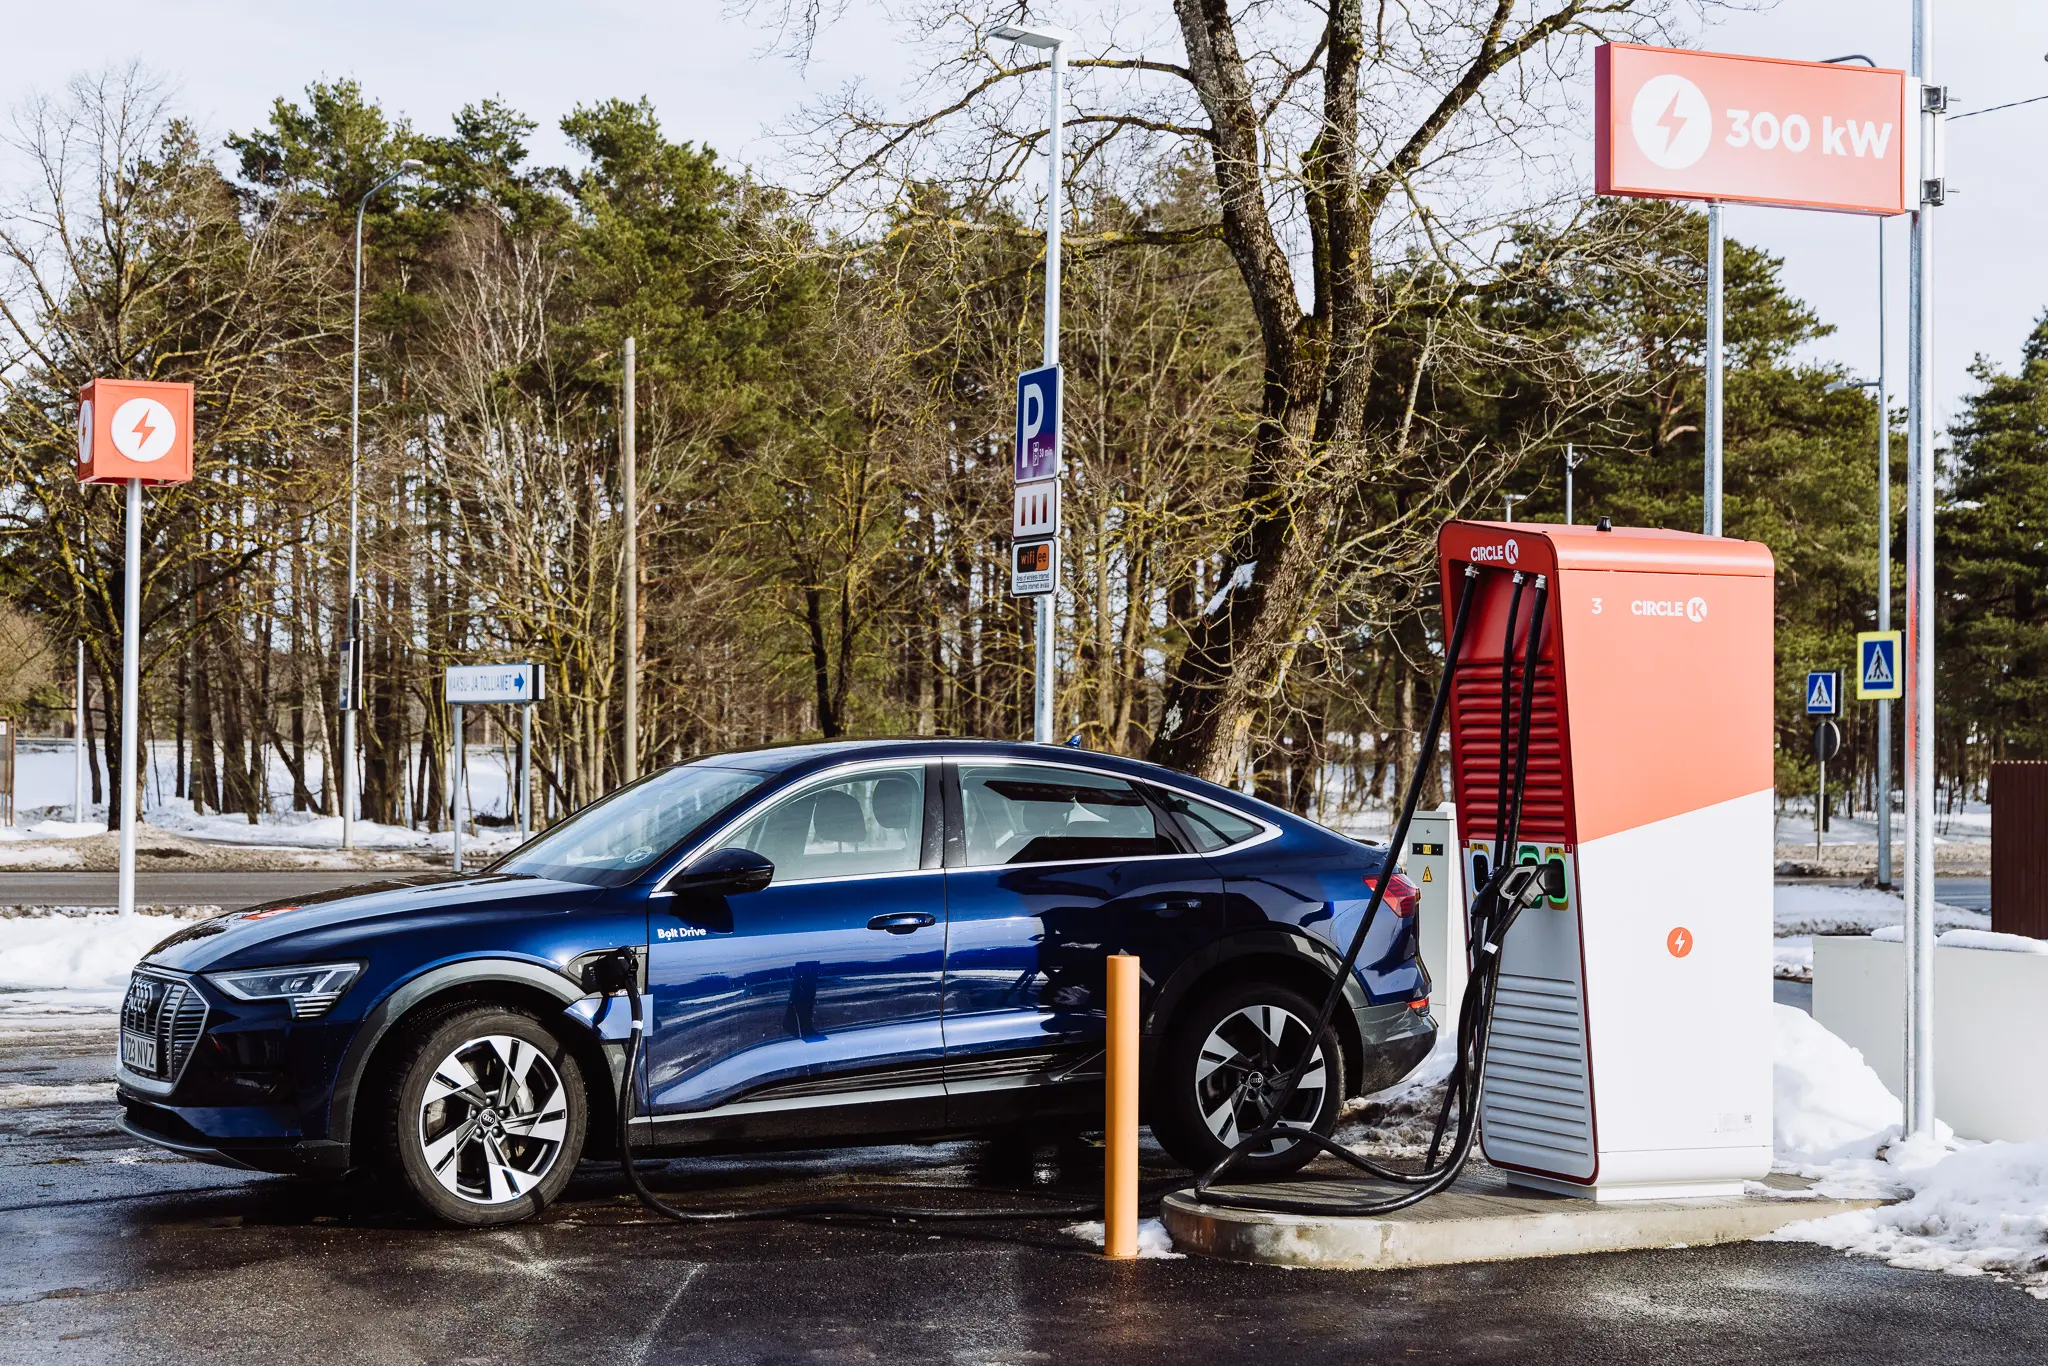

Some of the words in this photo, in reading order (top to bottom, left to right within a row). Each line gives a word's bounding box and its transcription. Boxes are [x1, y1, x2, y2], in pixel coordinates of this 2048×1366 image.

[1725, 108, 1811, 154] 300
[1822, 115, 1893, 159] kW
[1021, 383, 1044, 468] P
[1470, 545, 1504, 561] CIRCLE
[1507, 541, 1518, 563] K
[1591, 597, 1603, 615] 3
[1630, 599, 1684, 617] CIRCLE
[1690, 600, 1706, 621] K
[657, 928, 679, 941] Bolt
[679, 926, 707, 938] Drive
[138, 1040, 154, 1068] NVZ
